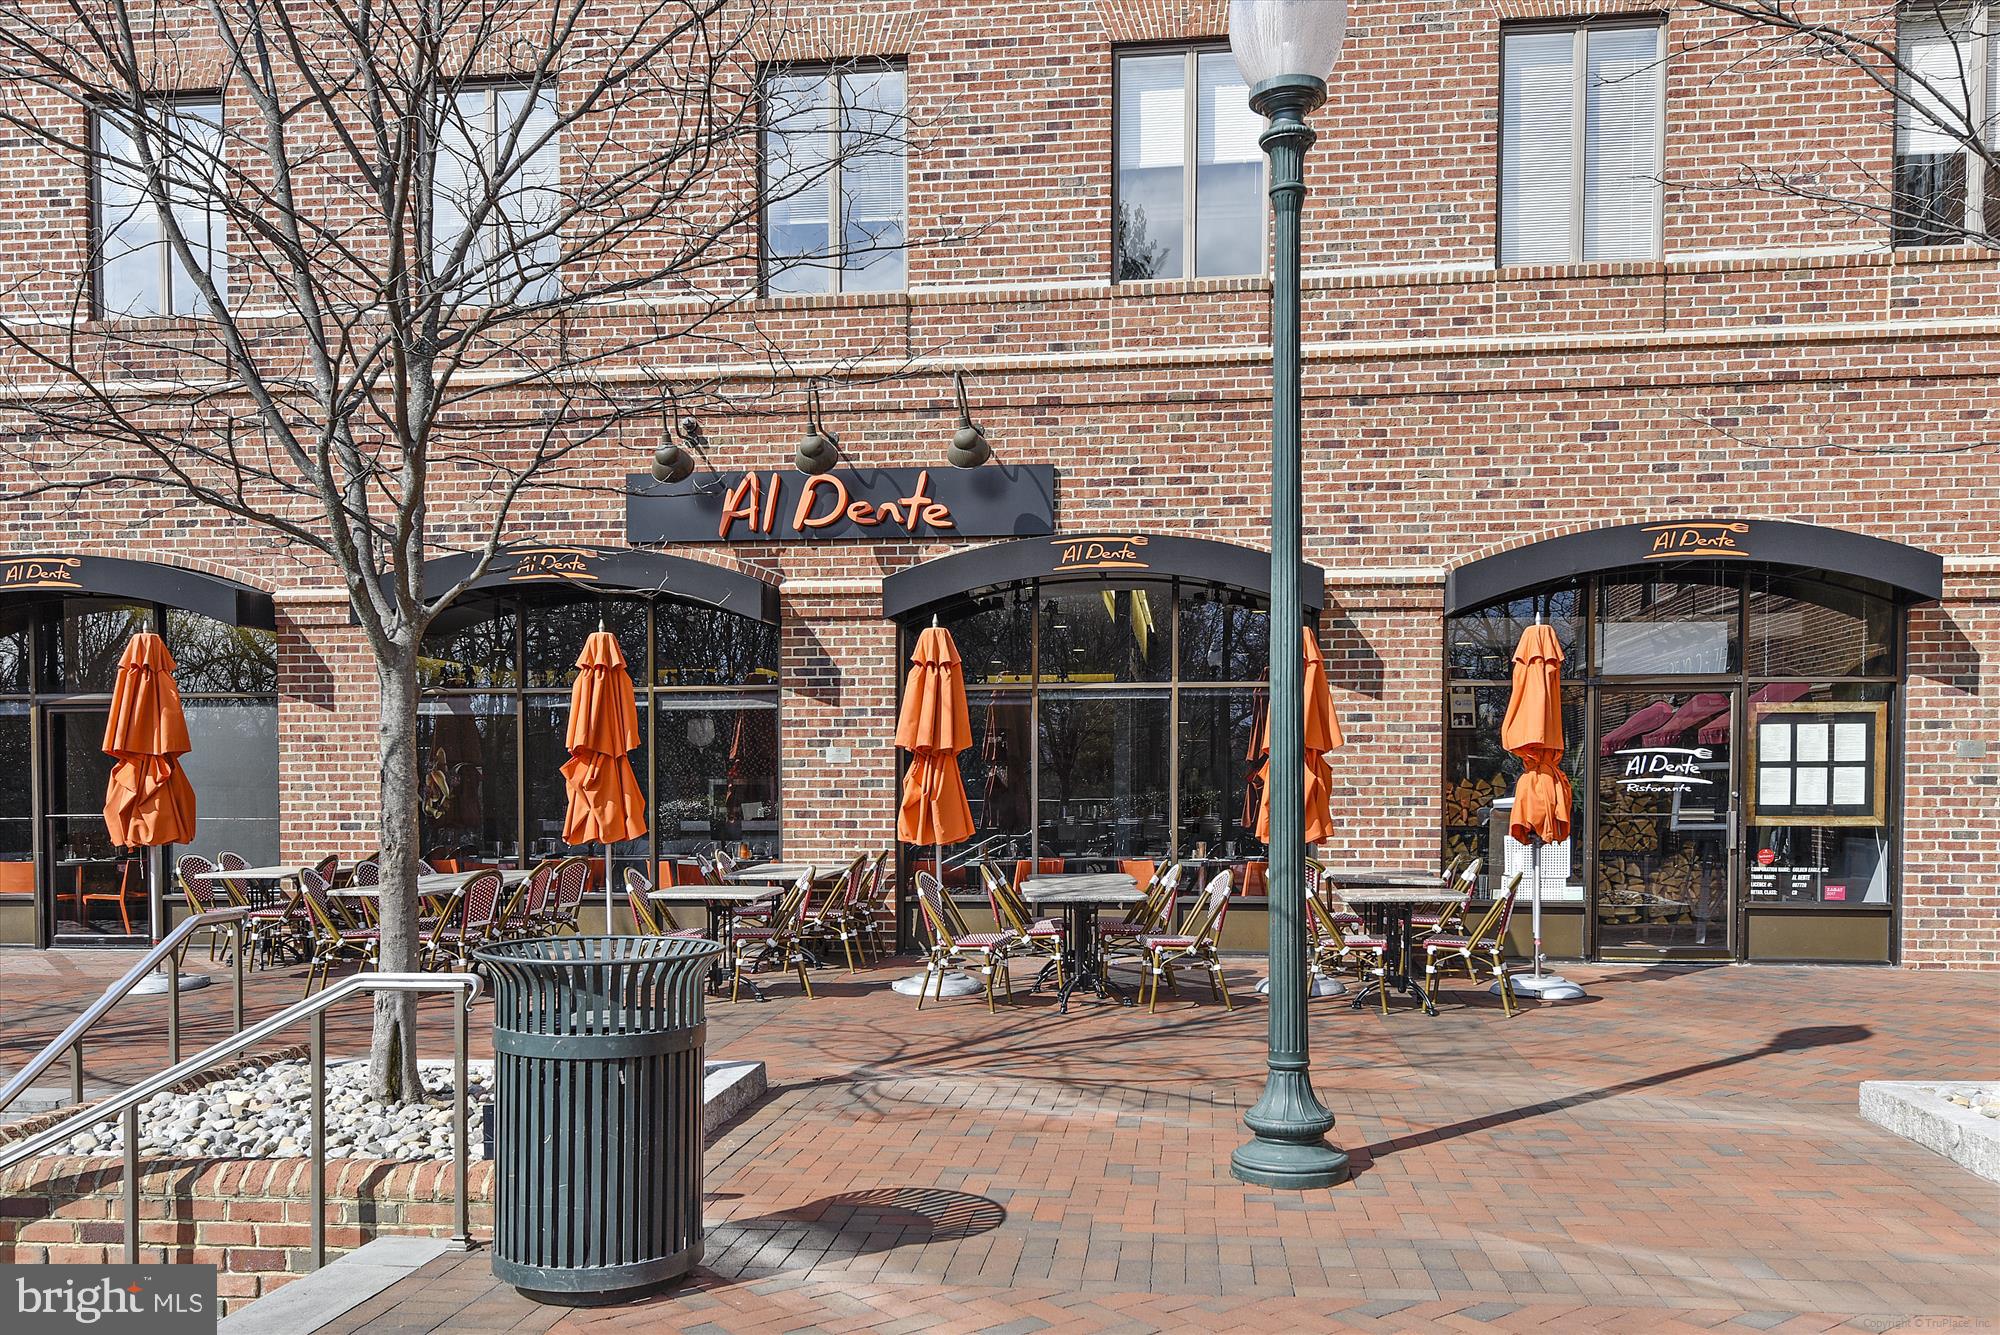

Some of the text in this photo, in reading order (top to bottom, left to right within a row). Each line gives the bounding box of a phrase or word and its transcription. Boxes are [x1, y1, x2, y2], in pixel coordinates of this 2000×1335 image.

[718, 470, 956, 539] Al Dente
[1653, 529, 1736, 552] Al Dente
[516, 554, 587, 574] Al Dente
[1061, 543, 1137, 564] Al Dente
[5, 563, 72, 583] Al Dente
[1625, 754, 1701, 776] Al Dente
[1626, 783, 1692, 792] Ristorante
